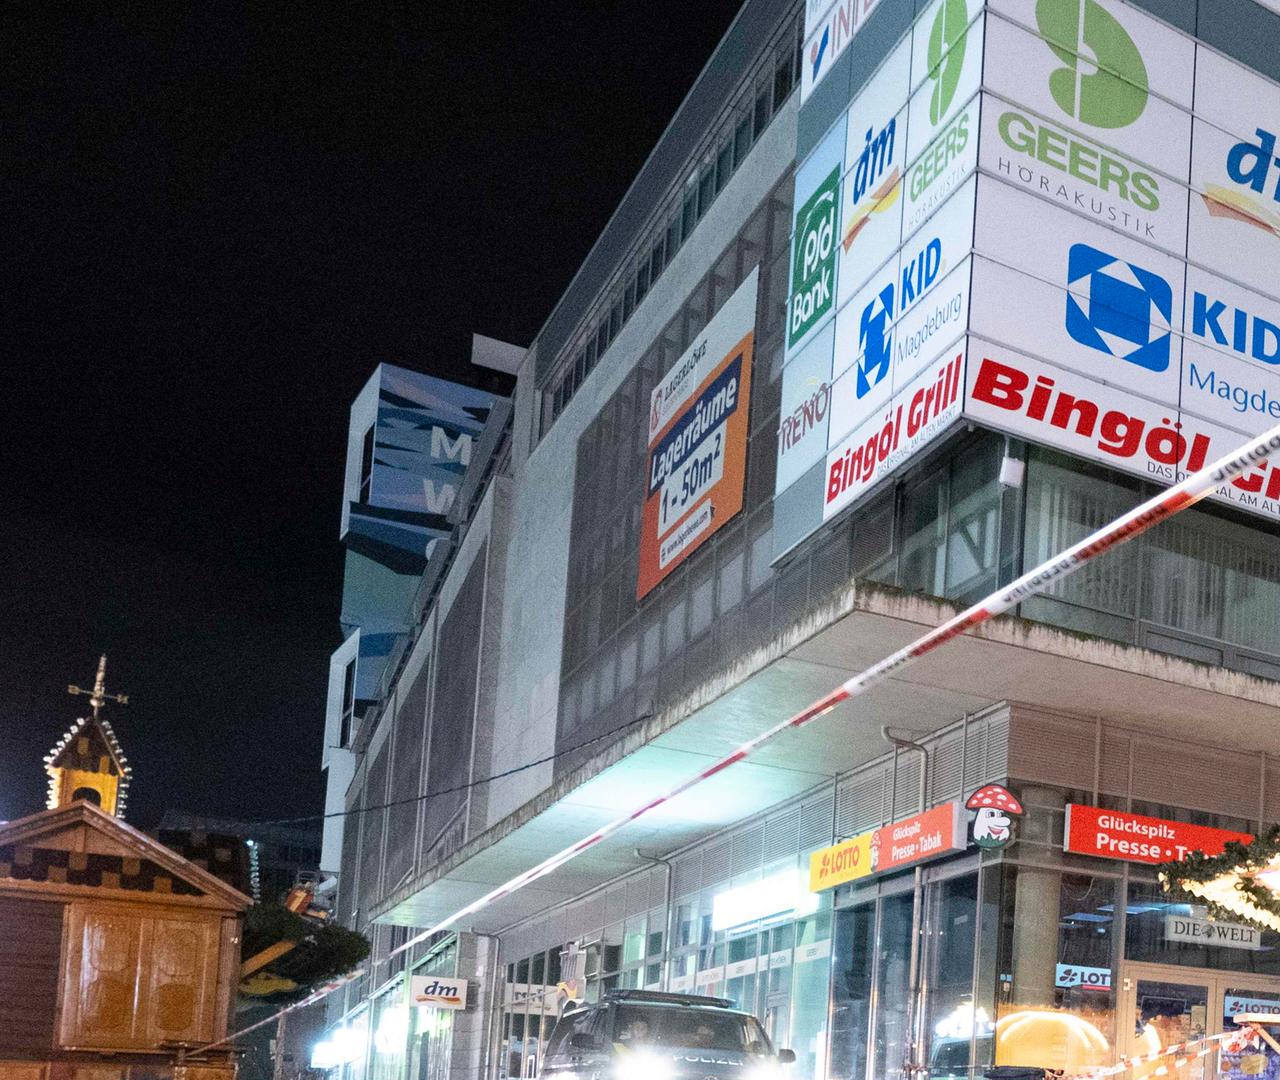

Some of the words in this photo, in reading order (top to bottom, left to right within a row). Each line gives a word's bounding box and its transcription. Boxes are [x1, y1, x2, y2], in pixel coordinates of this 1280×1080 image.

[853, 117, 896, 205] dm
[910, 113, 969, 203] GEERS
[998, 111, 1160, 212] GEERS
[998, 157, 1157, 239] HÖRAKUSTIK
[792, 267, 831, 334] Bank
[901, 238, 942, 311] KID
[897, 292, 962, 366] Magdeburg
[651, 376, 738, 490] Lagerräume
[780, 382, 829, 455] RENO
[827, 404, 903, 505] Bingöl
[907, 353, 963, 438] Grill
[971, 357, 1211, 472] Bingöl
[1147, 462, 1173, 481] DAS
[1239, 491, 1258, 508] AM
[831, 845, 861, 873] LOTTO
[892, 821, 921, 841] Glückspilz
[892, 843, 915, 862] Presse
[919, 831, 942, 851] Tabak
[1096, 833, 1161, 858] Presse
[1098, 815, 1176, 839] Glückspilz
[1174, 921, 1201, 935] DIE
[1217, 928, 1256, 942] WELT
[424, 981, 458, 997] dm
[1082, 972, 1111, 984] LOT
